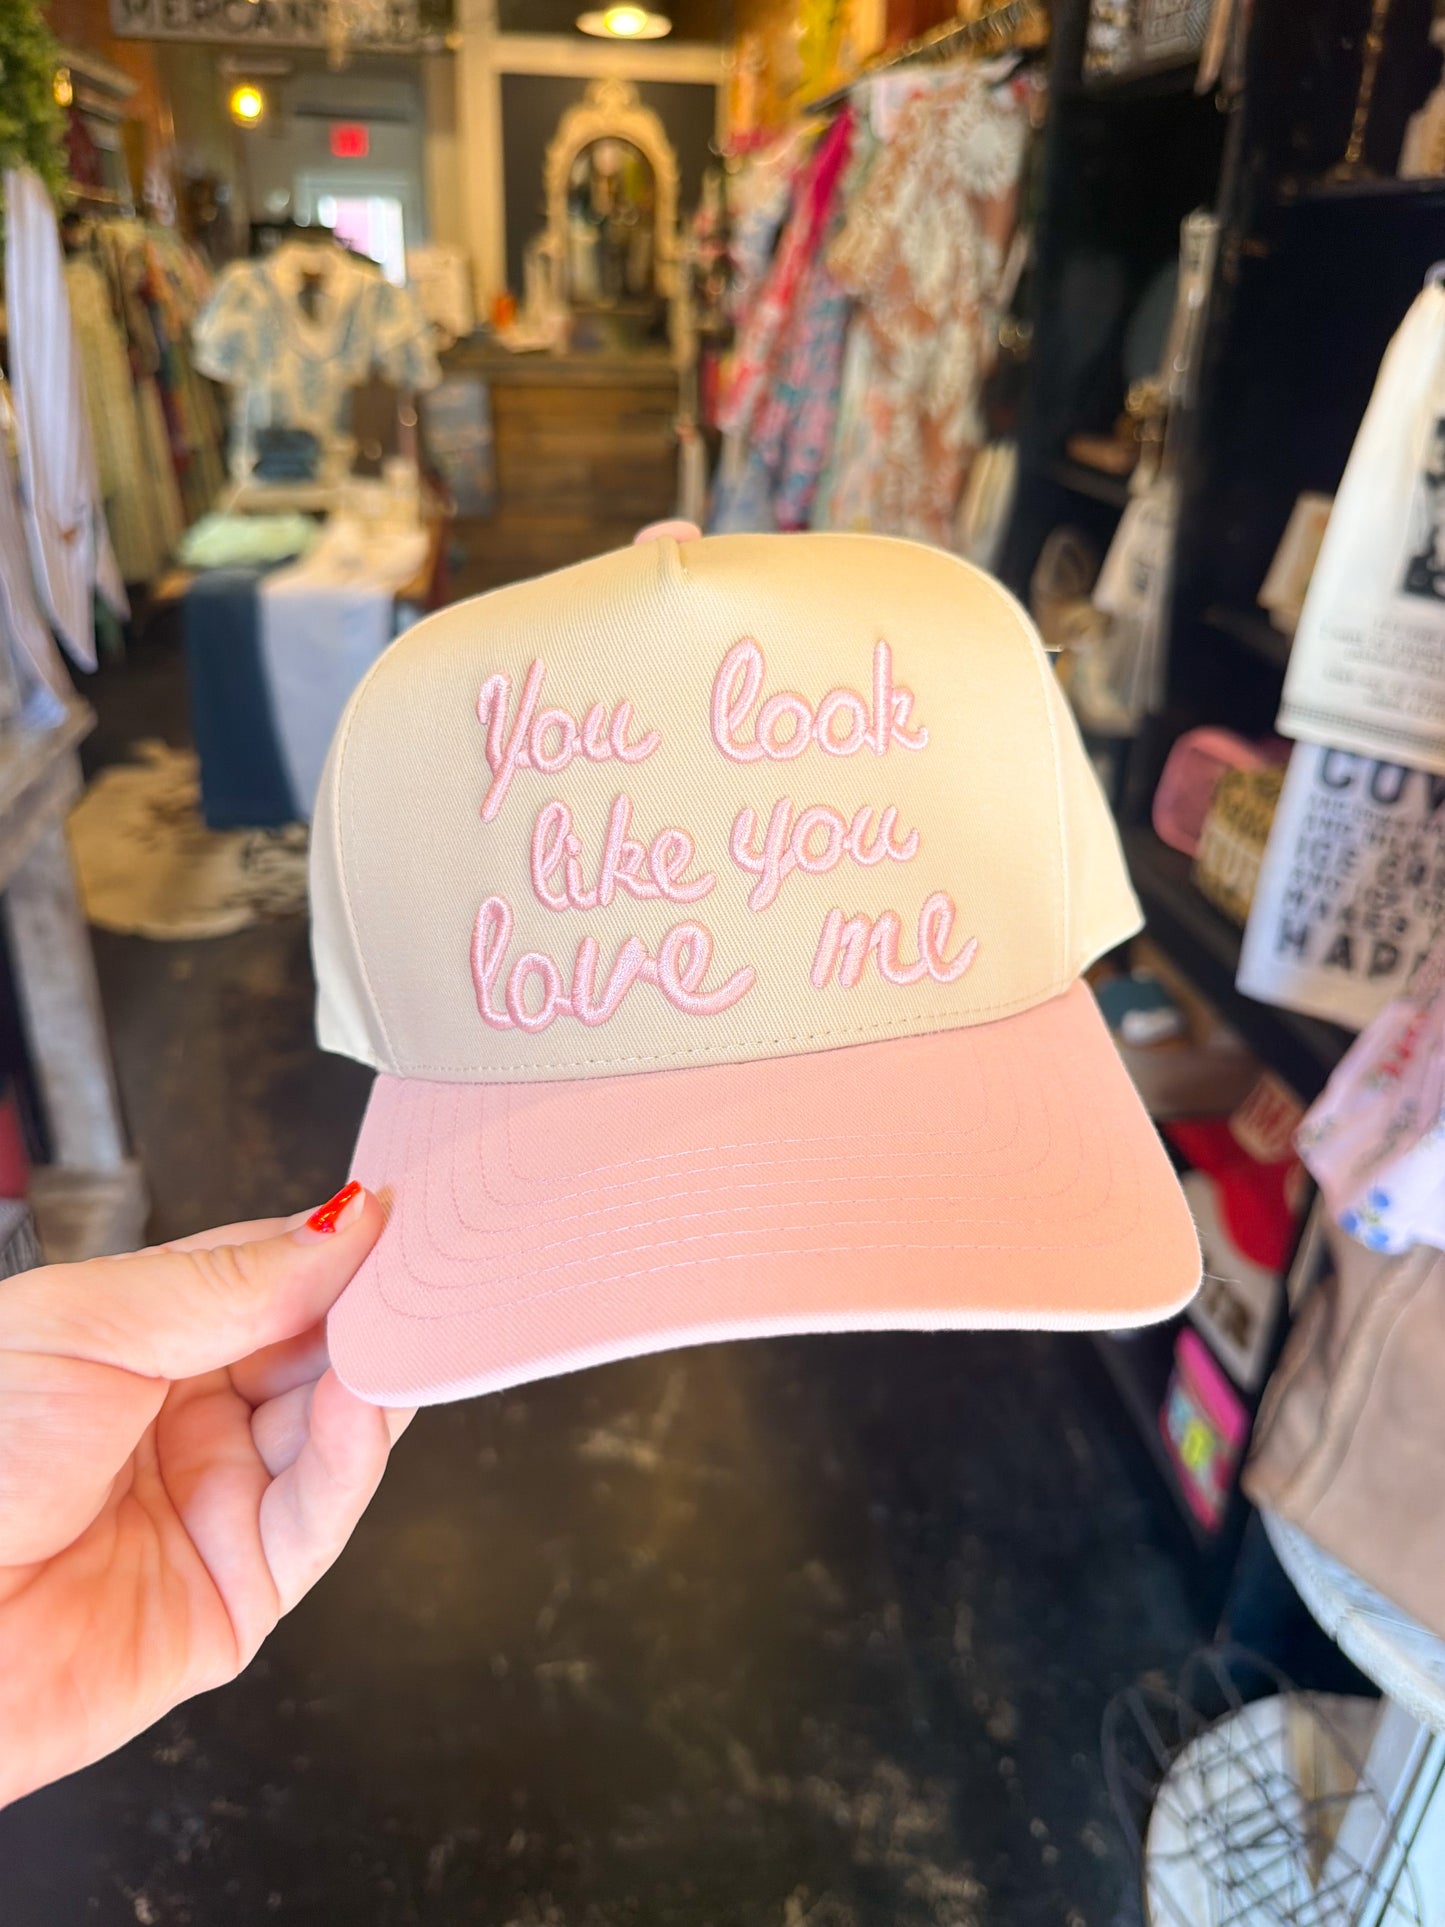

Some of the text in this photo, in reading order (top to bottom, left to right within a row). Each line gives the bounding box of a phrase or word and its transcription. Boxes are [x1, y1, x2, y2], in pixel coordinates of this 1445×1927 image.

[476, 636, 929, 823] You look
[530, 793, 920, 912] like you
[470, 891, 978, 1033] love me
